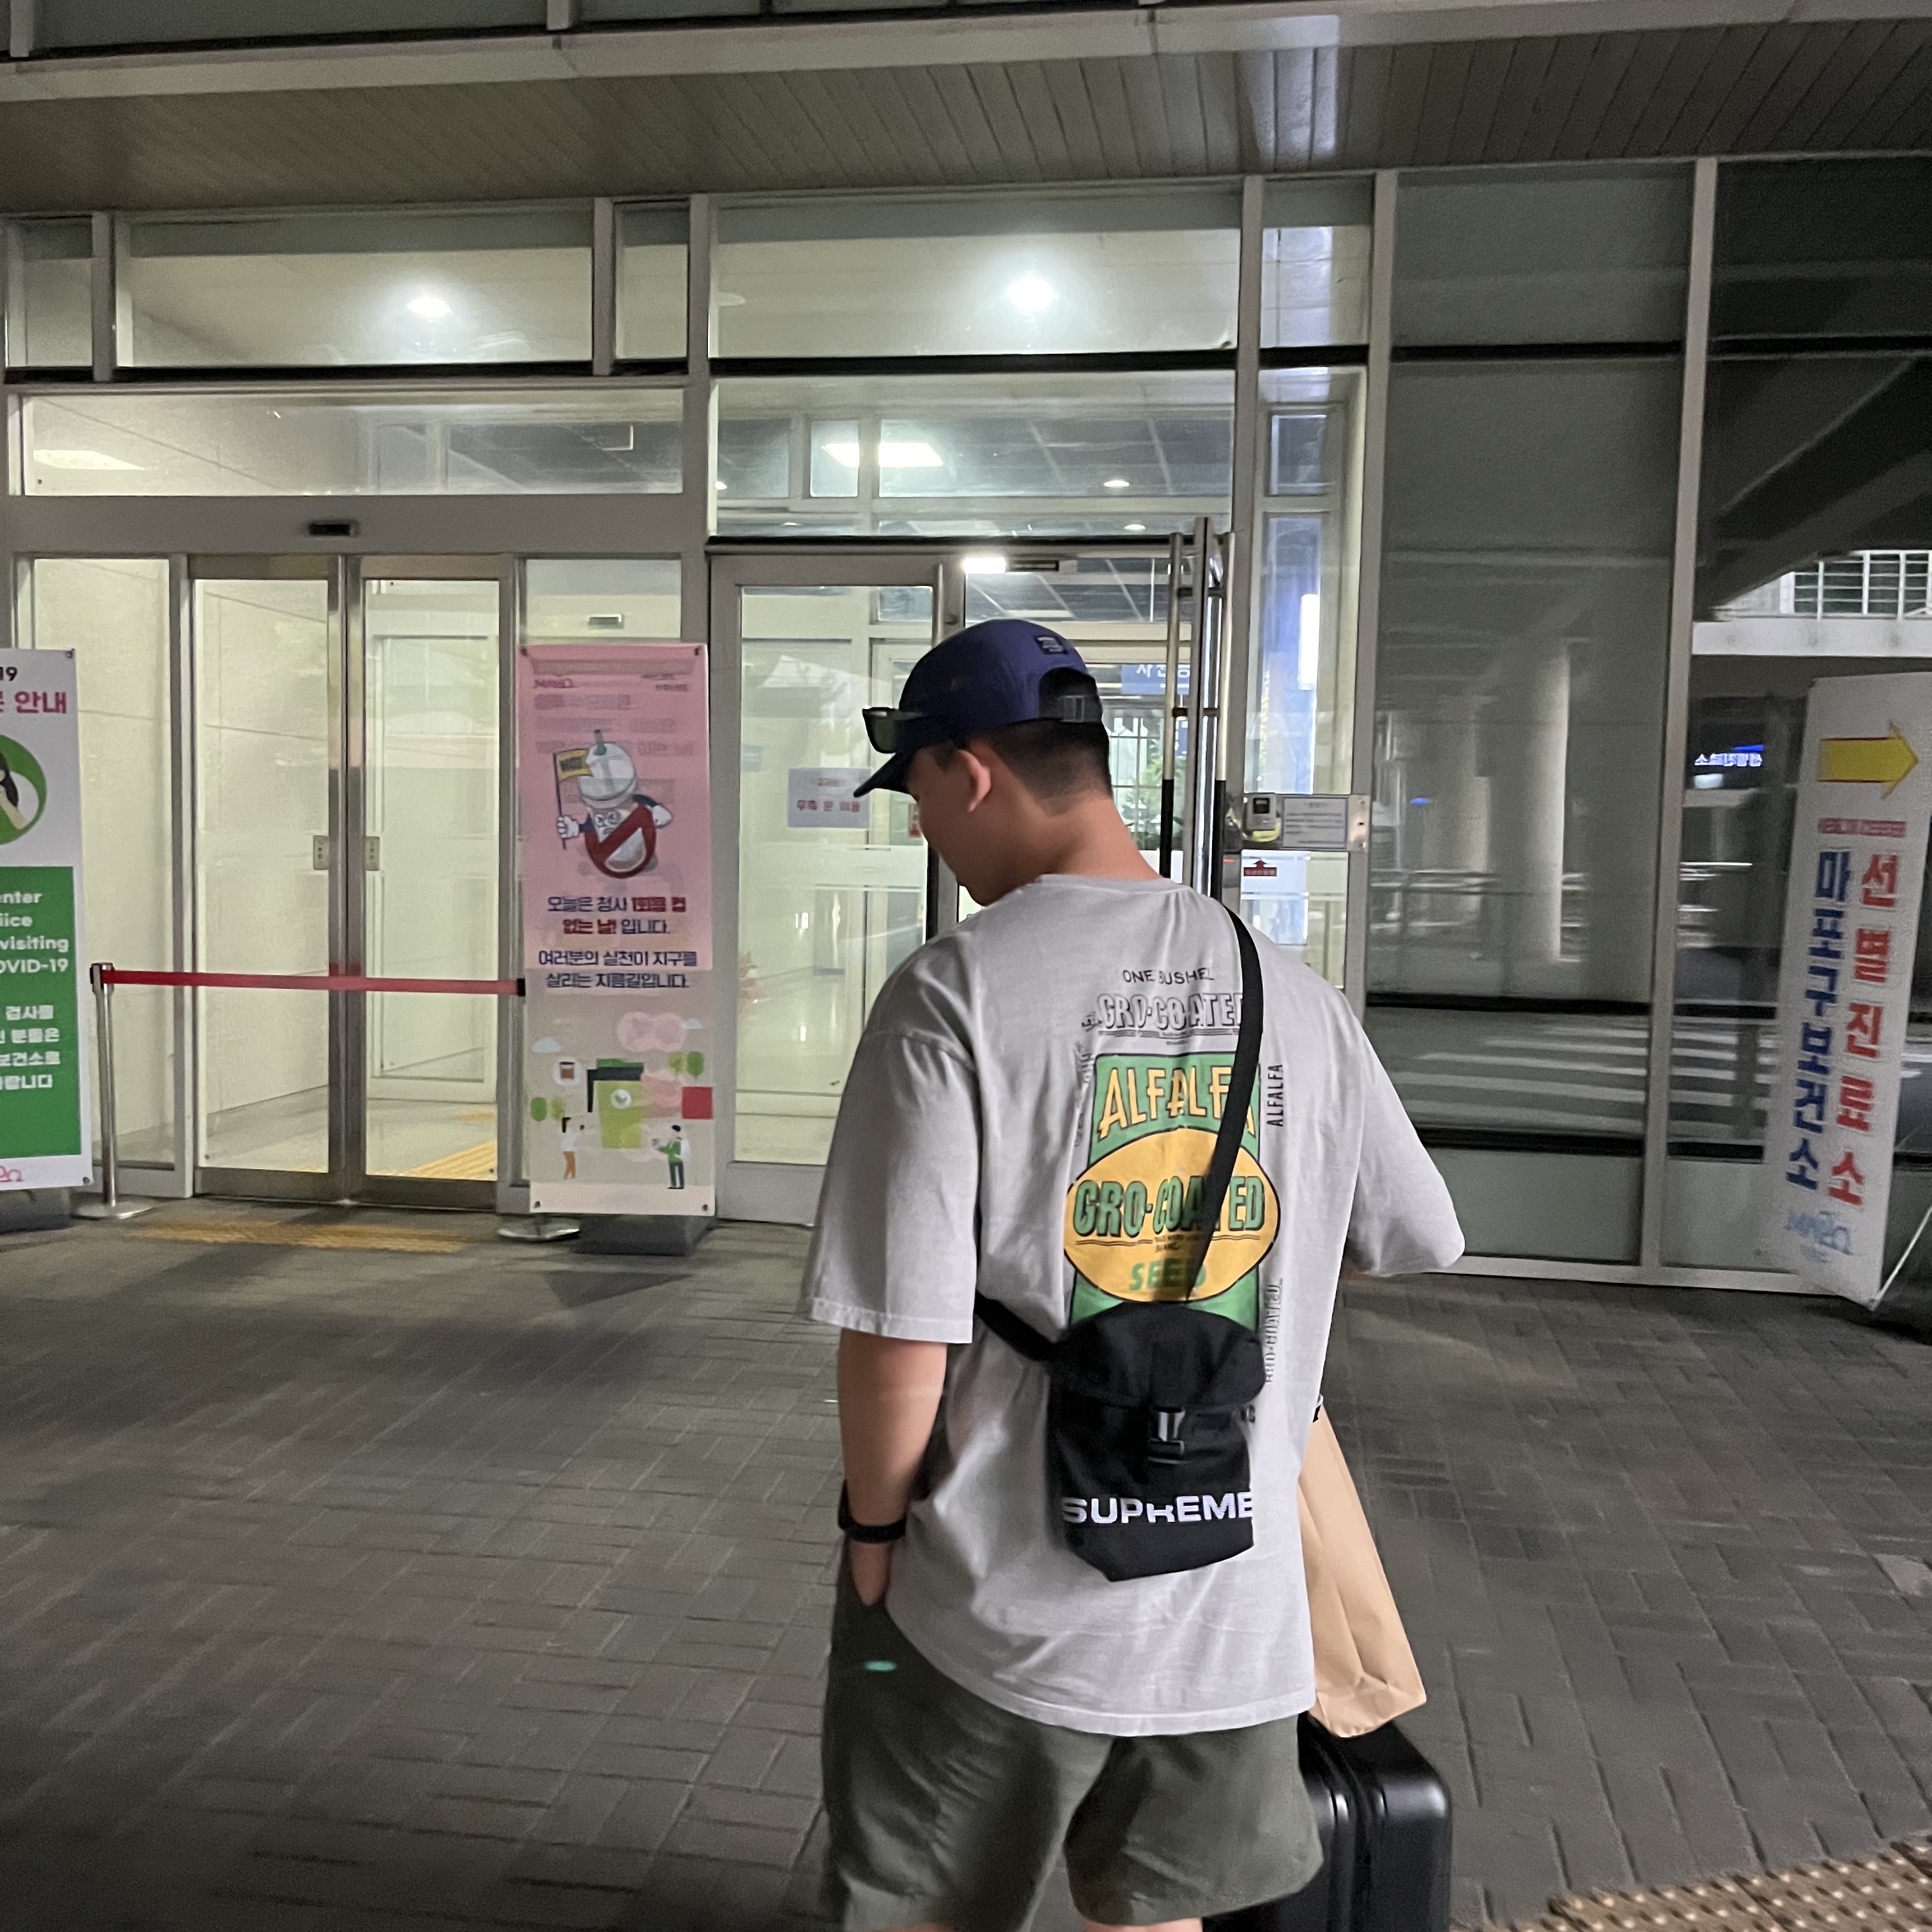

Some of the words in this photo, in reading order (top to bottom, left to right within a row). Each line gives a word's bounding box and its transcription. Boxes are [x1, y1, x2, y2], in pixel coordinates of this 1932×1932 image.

[14, 691, 67, 714] 안내
[0, 891, 42, 903] nter
[547, 896, 593, 912] 오늘은
[597, 896, 627, 912] 청사
[562, 919, 593, 935] 없는
[0, 936, 69, 953] visiting
[539, 950, 599, 966] 여러분의
[603, 950, 648, 967] 실천이
[653, 951, 698, 967] 지구를
[546, 973, 592, 988] 살리는
[1123, 969, 1154, 983] ONE
[1786, 851, 1851, 1191] 마포구보건소
[1828, 854, 1899, 1206] 선별진료소
[0, 1075, 52, 1090] 랍니다
[1267, 1064, 1284, 1128] ALFALFA
[1073, 1175, 1266, 1238] GRO-COAED
[1062, 1491, 1253, 1525] SUPREME
